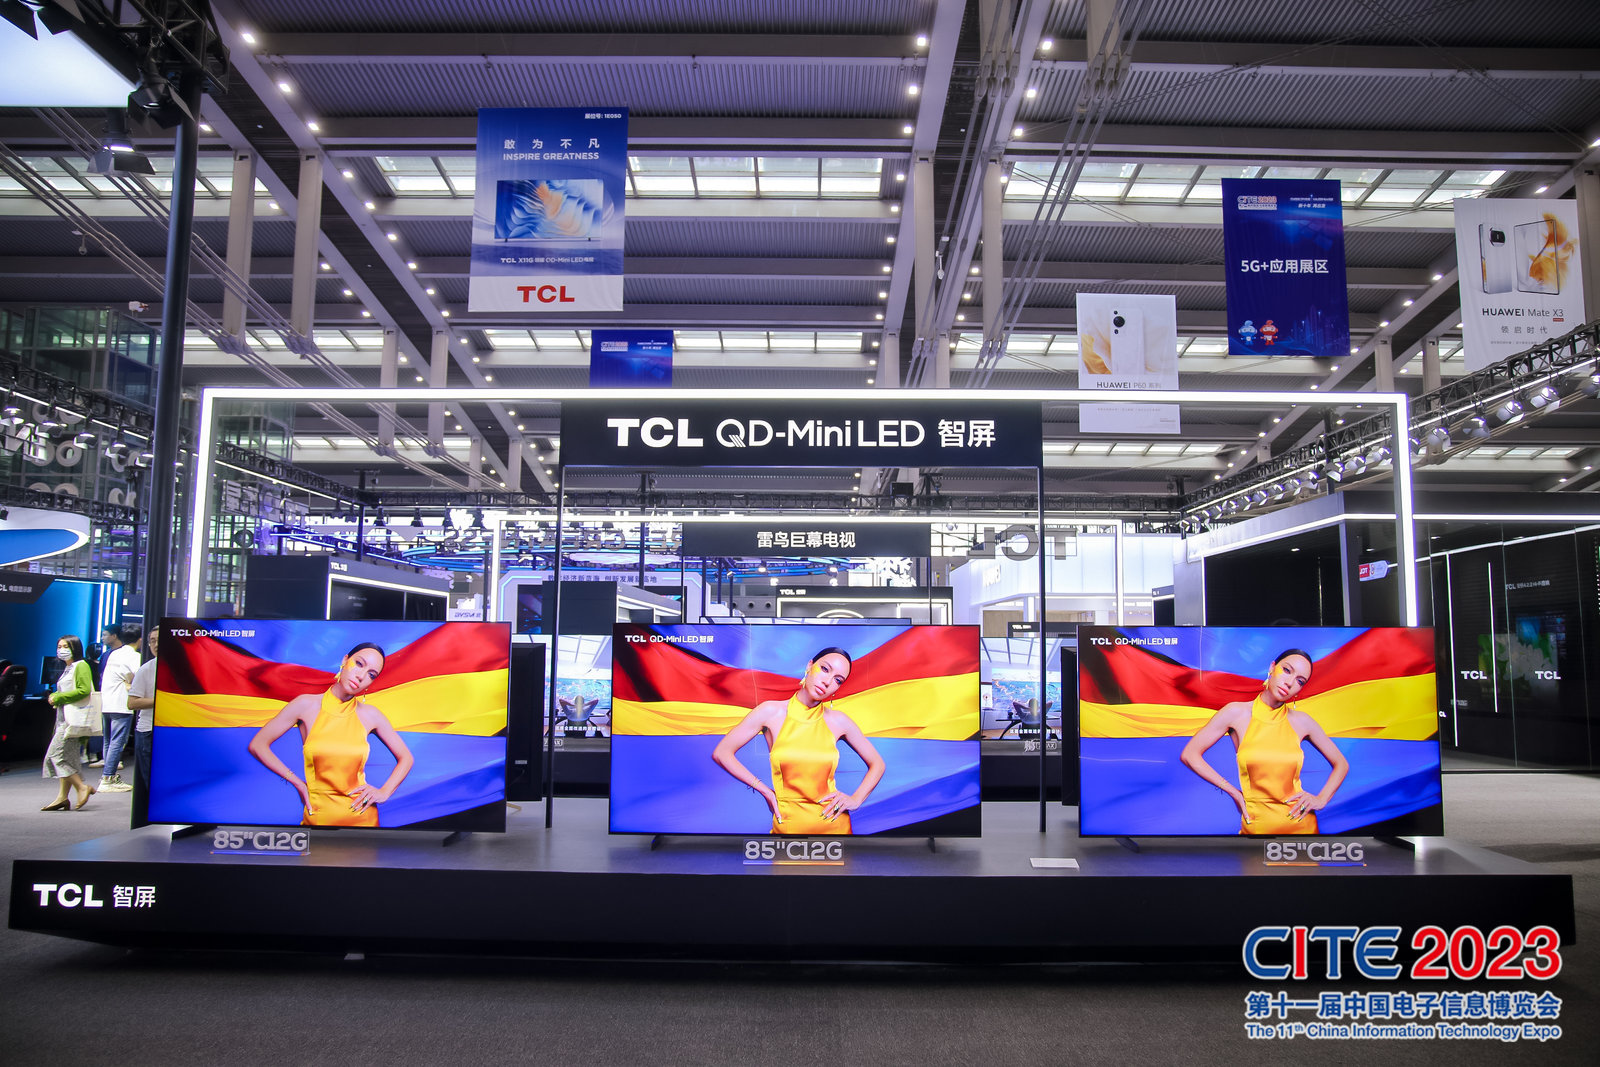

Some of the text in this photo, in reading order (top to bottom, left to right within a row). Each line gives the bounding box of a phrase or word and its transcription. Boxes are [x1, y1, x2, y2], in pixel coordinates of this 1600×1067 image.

[503, 152, 600, 161] INSPIRE GREATNESS
[1241, 259, 1329, 274] 5G+应用展区
[517, 285, 575, 303] TCL
[1482, 308, 1564, 317] HUAWEI Mate X3
[607, 417, 704, 449] TCL
[937, 418, 996, 448] 智屏
[756, 531, 856, 549] 雷鸟巨幕电视
[171, 629, 191, 637] TCL
[624, 635, 646, 643] TCL
[1090, 637, 1112, 645] TCL
[1461, 670, 1487, 680] TCL
[1534, 670, 1561, 680] TCL
[33, 883, 156, 908] TCL 智屏
